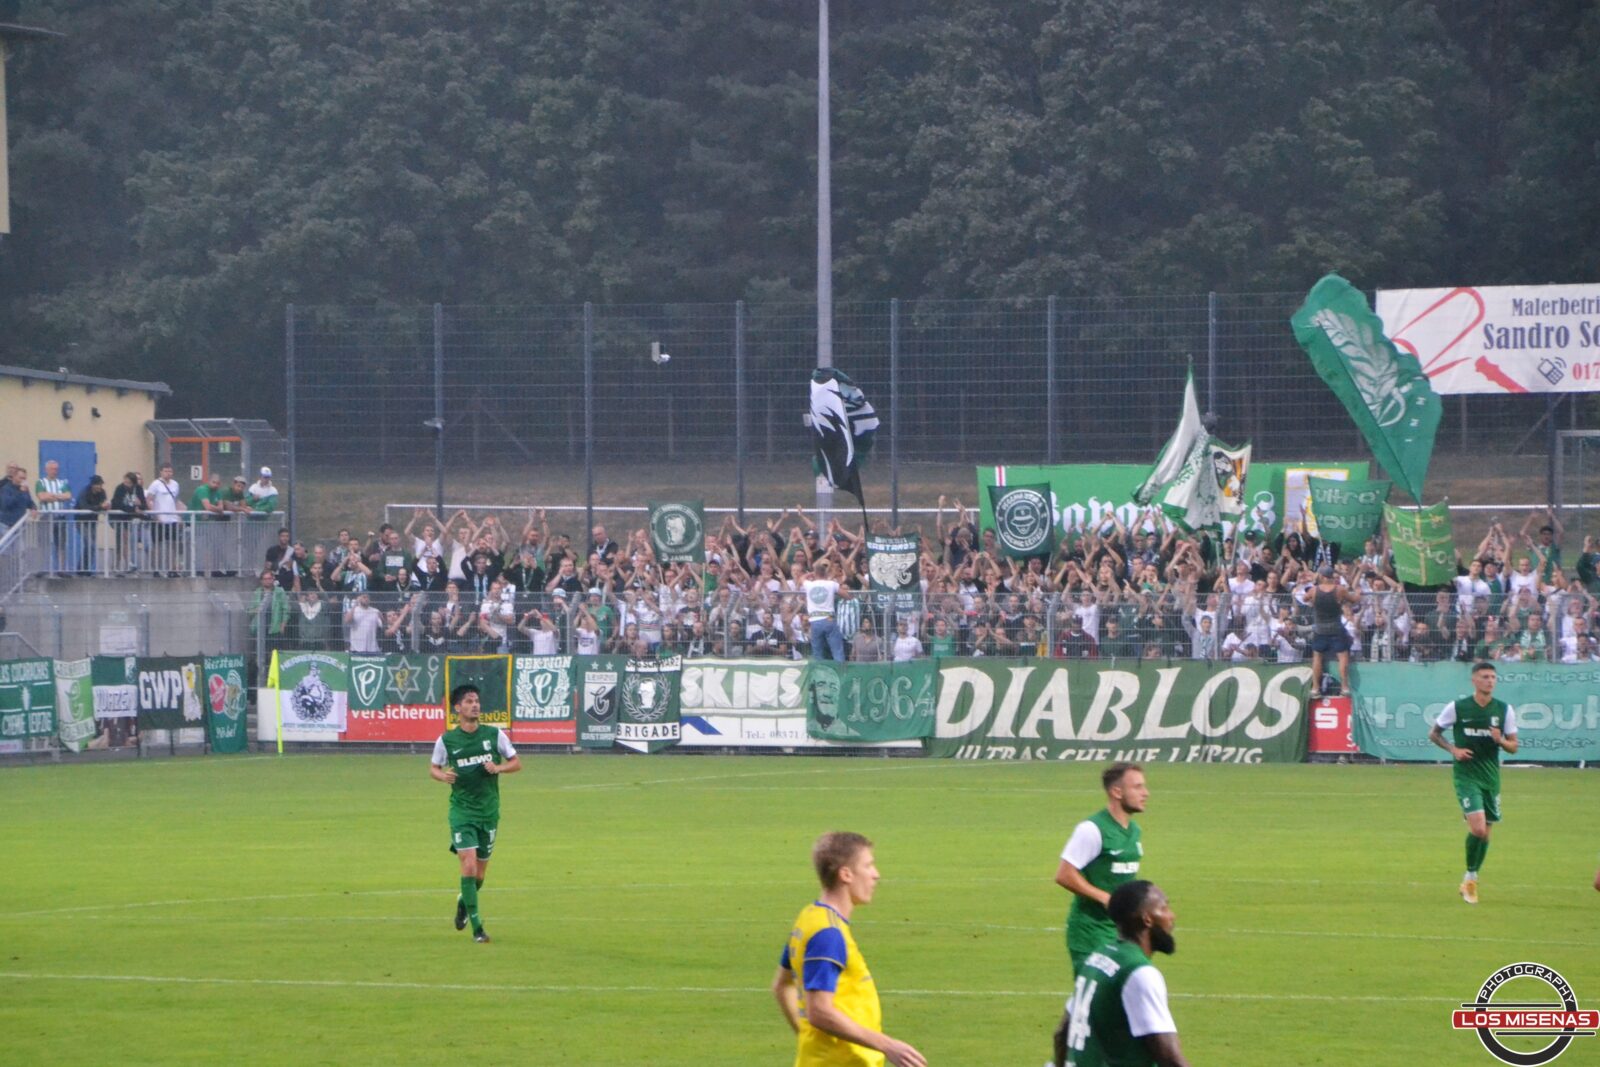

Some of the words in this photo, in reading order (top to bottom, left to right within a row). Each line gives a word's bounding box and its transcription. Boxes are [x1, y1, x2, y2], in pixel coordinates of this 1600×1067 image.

[1483, 322, 1570, 350] Sandro
[138, 670, 183, 709] GWP
[680, 667, 802, 708] SKINS
[846, 674, 936, 723] 1964
[934, 666, 1313, 741] DIABLOS
[616, 724, 679, 738] BRIGADE
